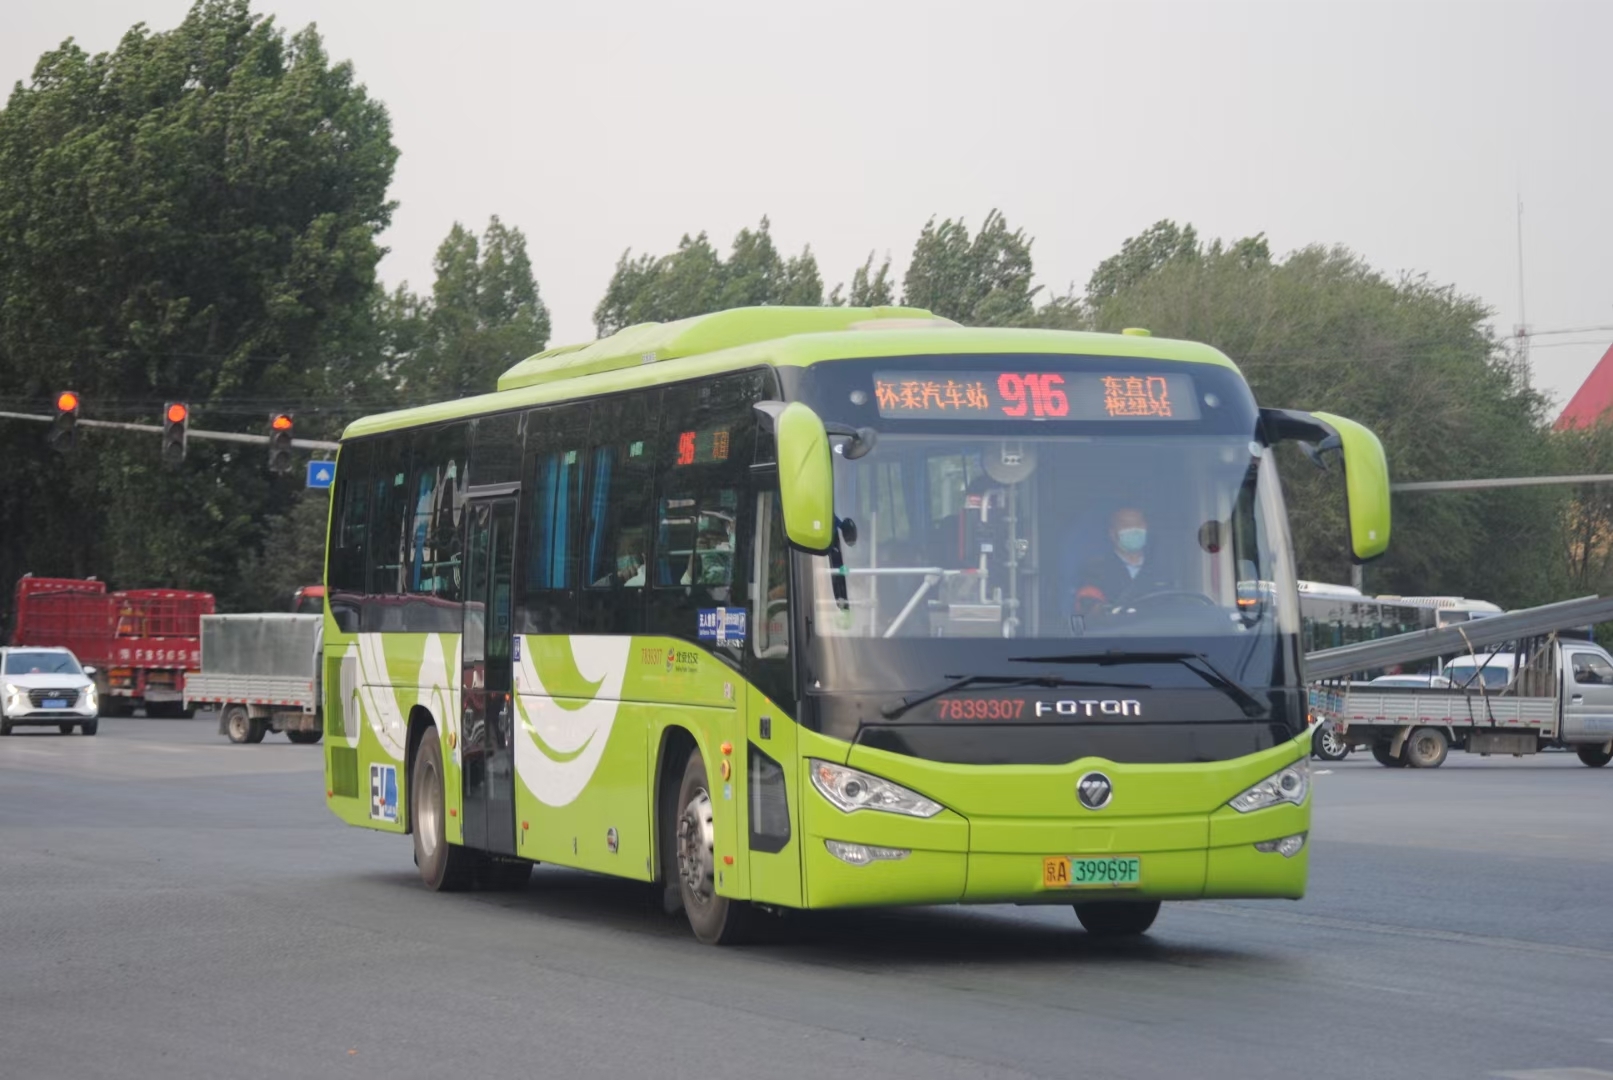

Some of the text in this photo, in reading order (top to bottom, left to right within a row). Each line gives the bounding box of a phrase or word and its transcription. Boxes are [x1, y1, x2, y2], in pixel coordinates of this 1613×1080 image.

[875, 379, 989, 410] 怀柔汽车站
[997, 373, 1069, 417] 916
[1101, 376, 1168, 398] 东直门
[1104, 397, 1172, 417] 枢纽站
[937, 700, 1025, 720] 7839307
[1046, 859, 1139, 882] 京A 39969F
